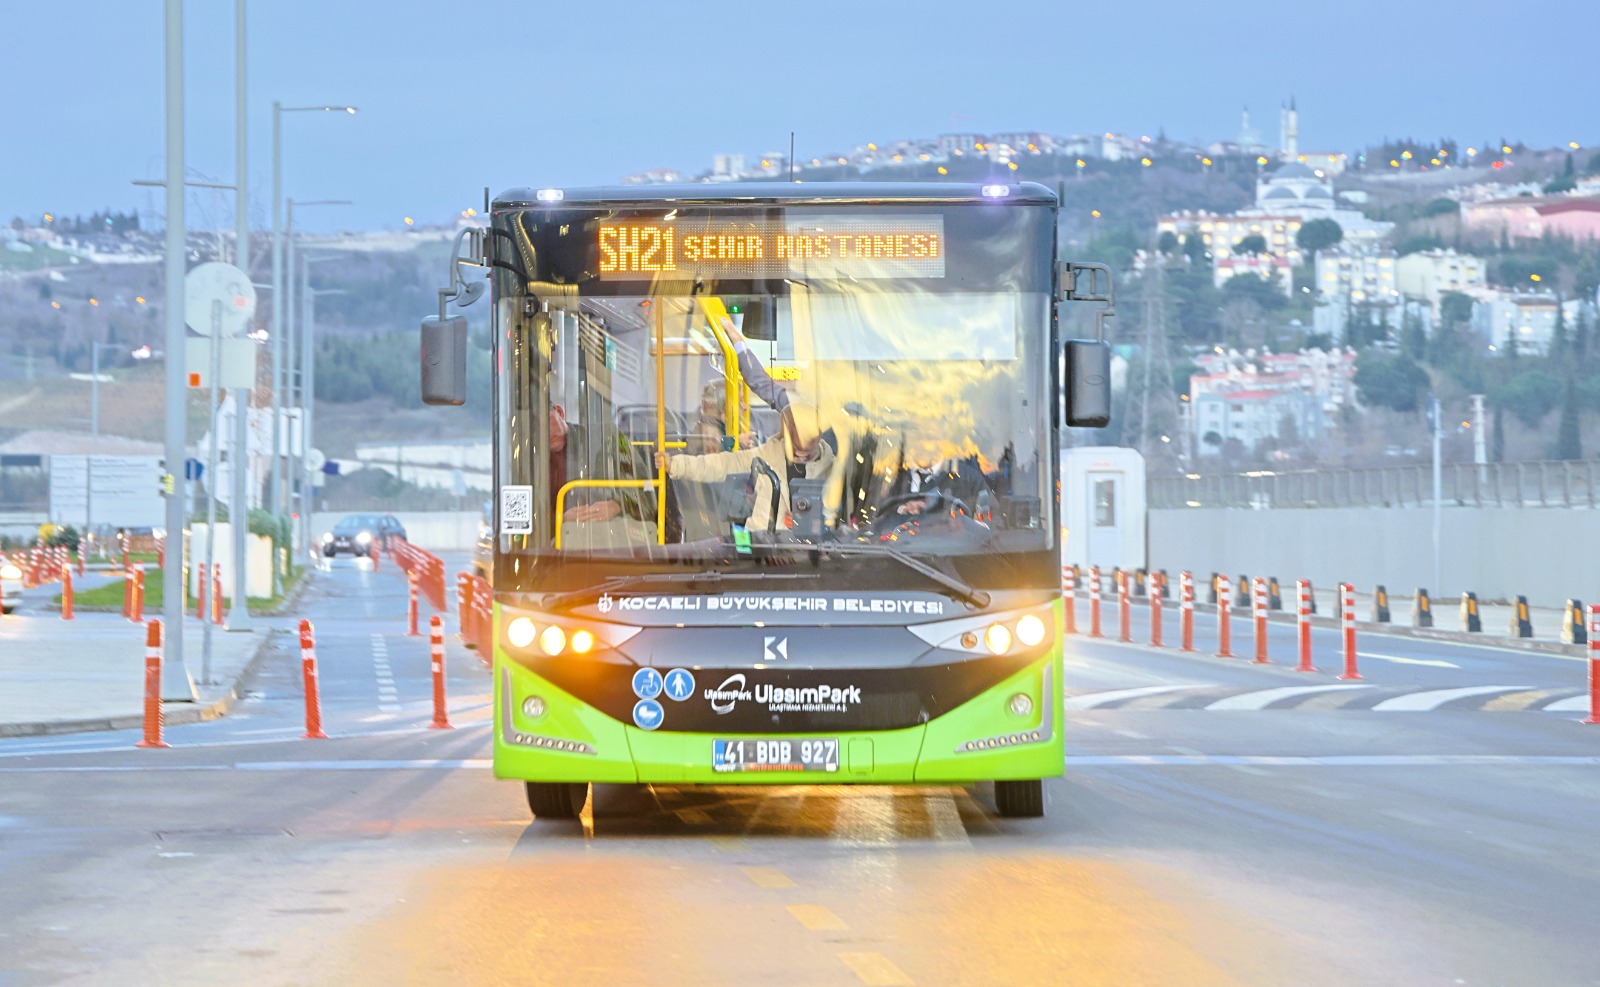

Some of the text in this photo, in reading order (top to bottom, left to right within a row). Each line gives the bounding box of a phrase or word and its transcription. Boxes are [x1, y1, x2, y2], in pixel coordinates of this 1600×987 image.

[600, 226, 677, 271] SH21
[725, 741, 744, 764] 41
[756, 741, 792, 764] BDB
[801, 741, 836, 764] 927
